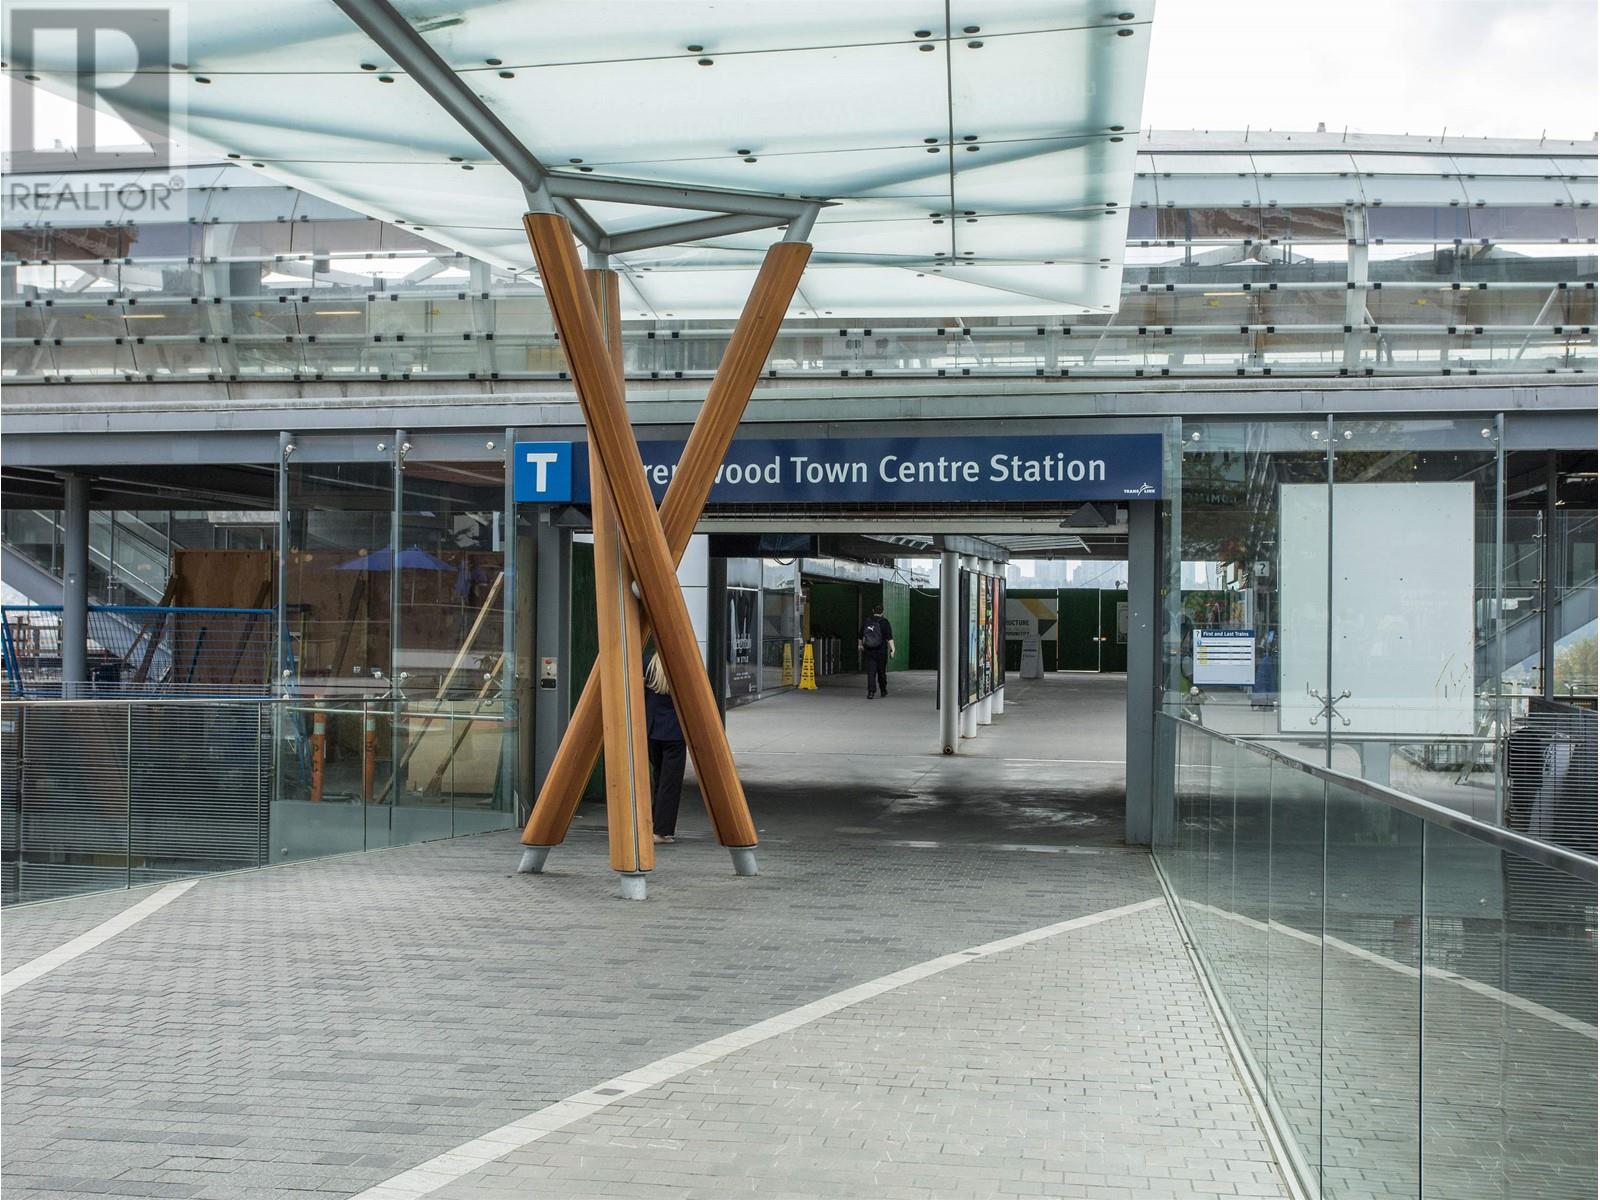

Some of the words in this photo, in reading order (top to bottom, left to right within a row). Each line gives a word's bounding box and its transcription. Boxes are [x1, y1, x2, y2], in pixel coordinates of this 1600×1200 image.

[526, 453, 558, 492] T
[790, 456, 867, 484] Town
[879, 455, 980, 483] Centre
[989, 452, 1106, 482] Station
